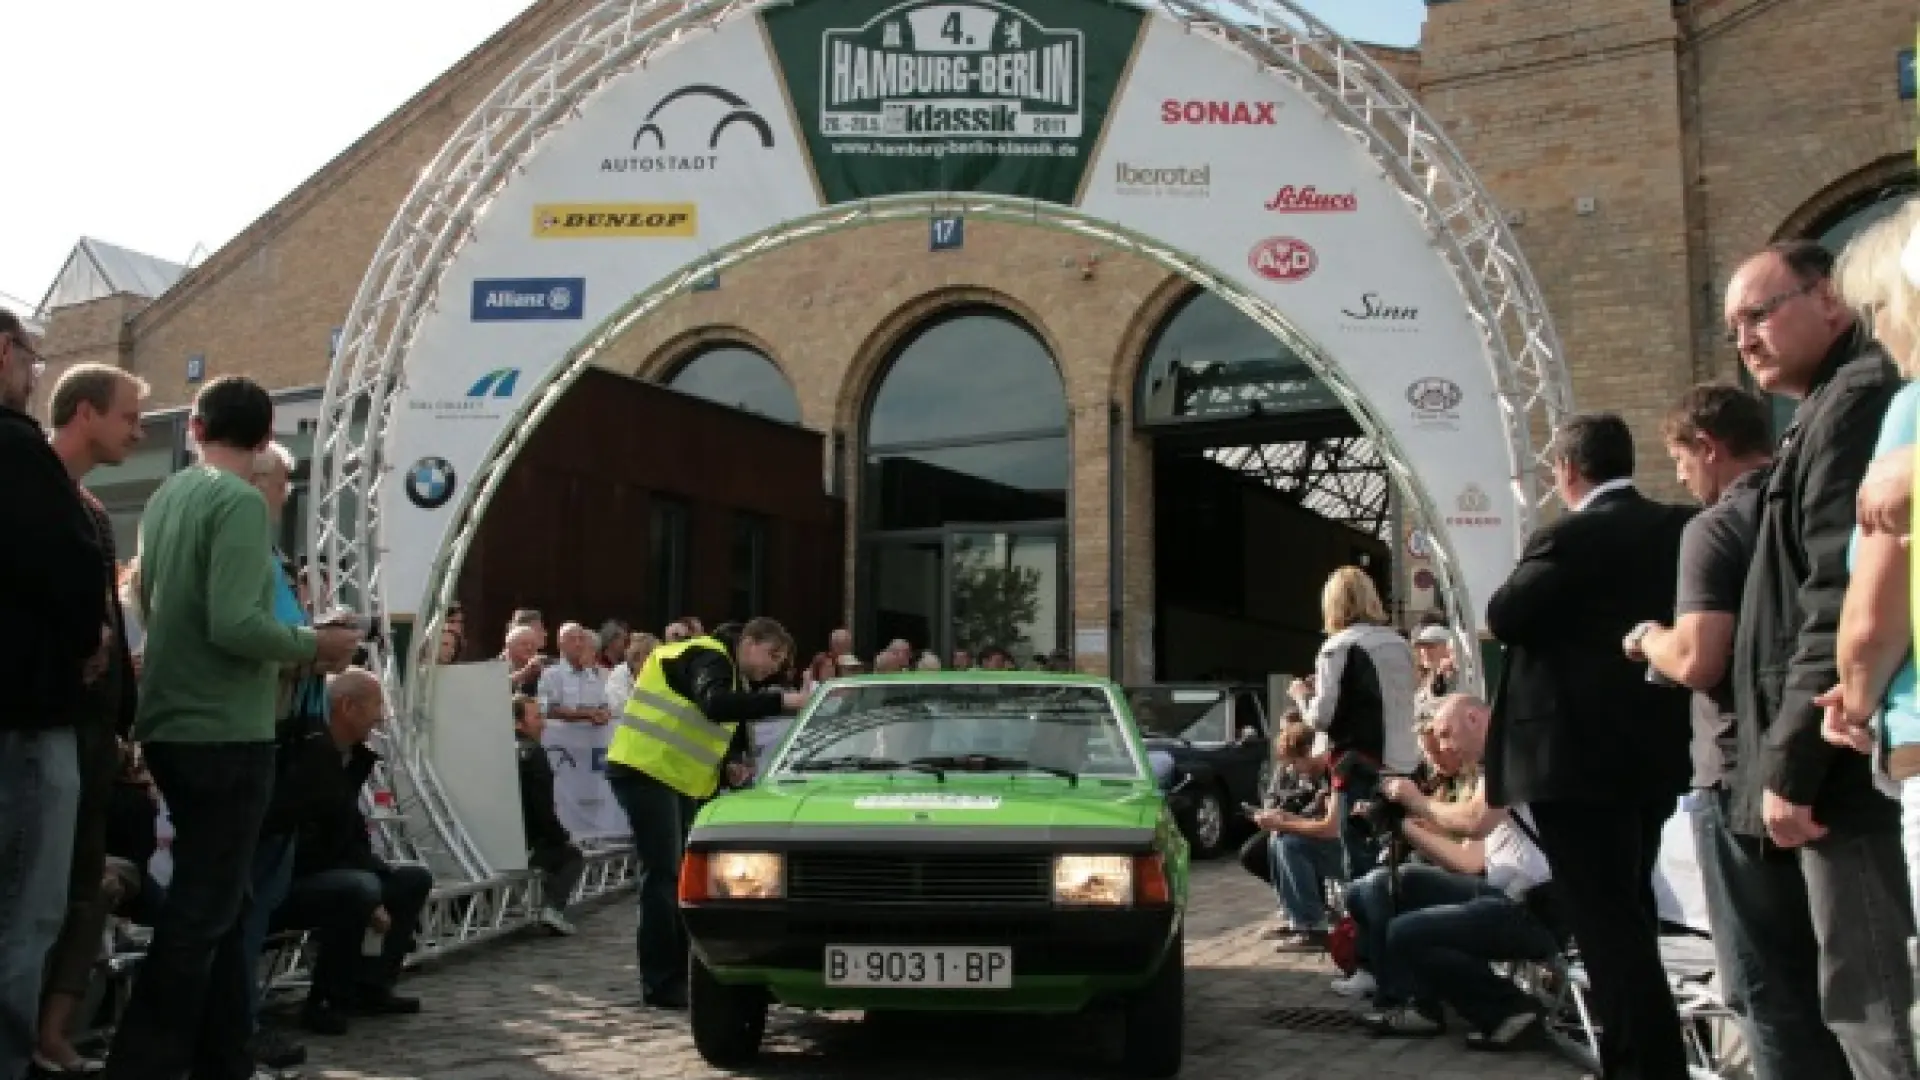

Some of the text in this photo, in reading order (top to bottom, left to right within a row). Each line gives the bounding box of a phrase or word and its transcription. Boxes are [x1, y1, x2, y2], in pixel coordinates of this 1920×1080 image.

[832, 40, 1073, 105] HAMBURG-BERLIN
[905, 104, 1017, 132] klassik
[1161, 99, 1277, 124] SONAX
[1033, 117, 1066, 133] 2011
[600, 155, 717, 172] AUTOSTADT
[1116, 162, 1211, 185] Iberotel
[563, 213, 689, 227] DUNLOP
[933, 219, 955, 243] 17
[485, 291, 545, 307] Allianz
